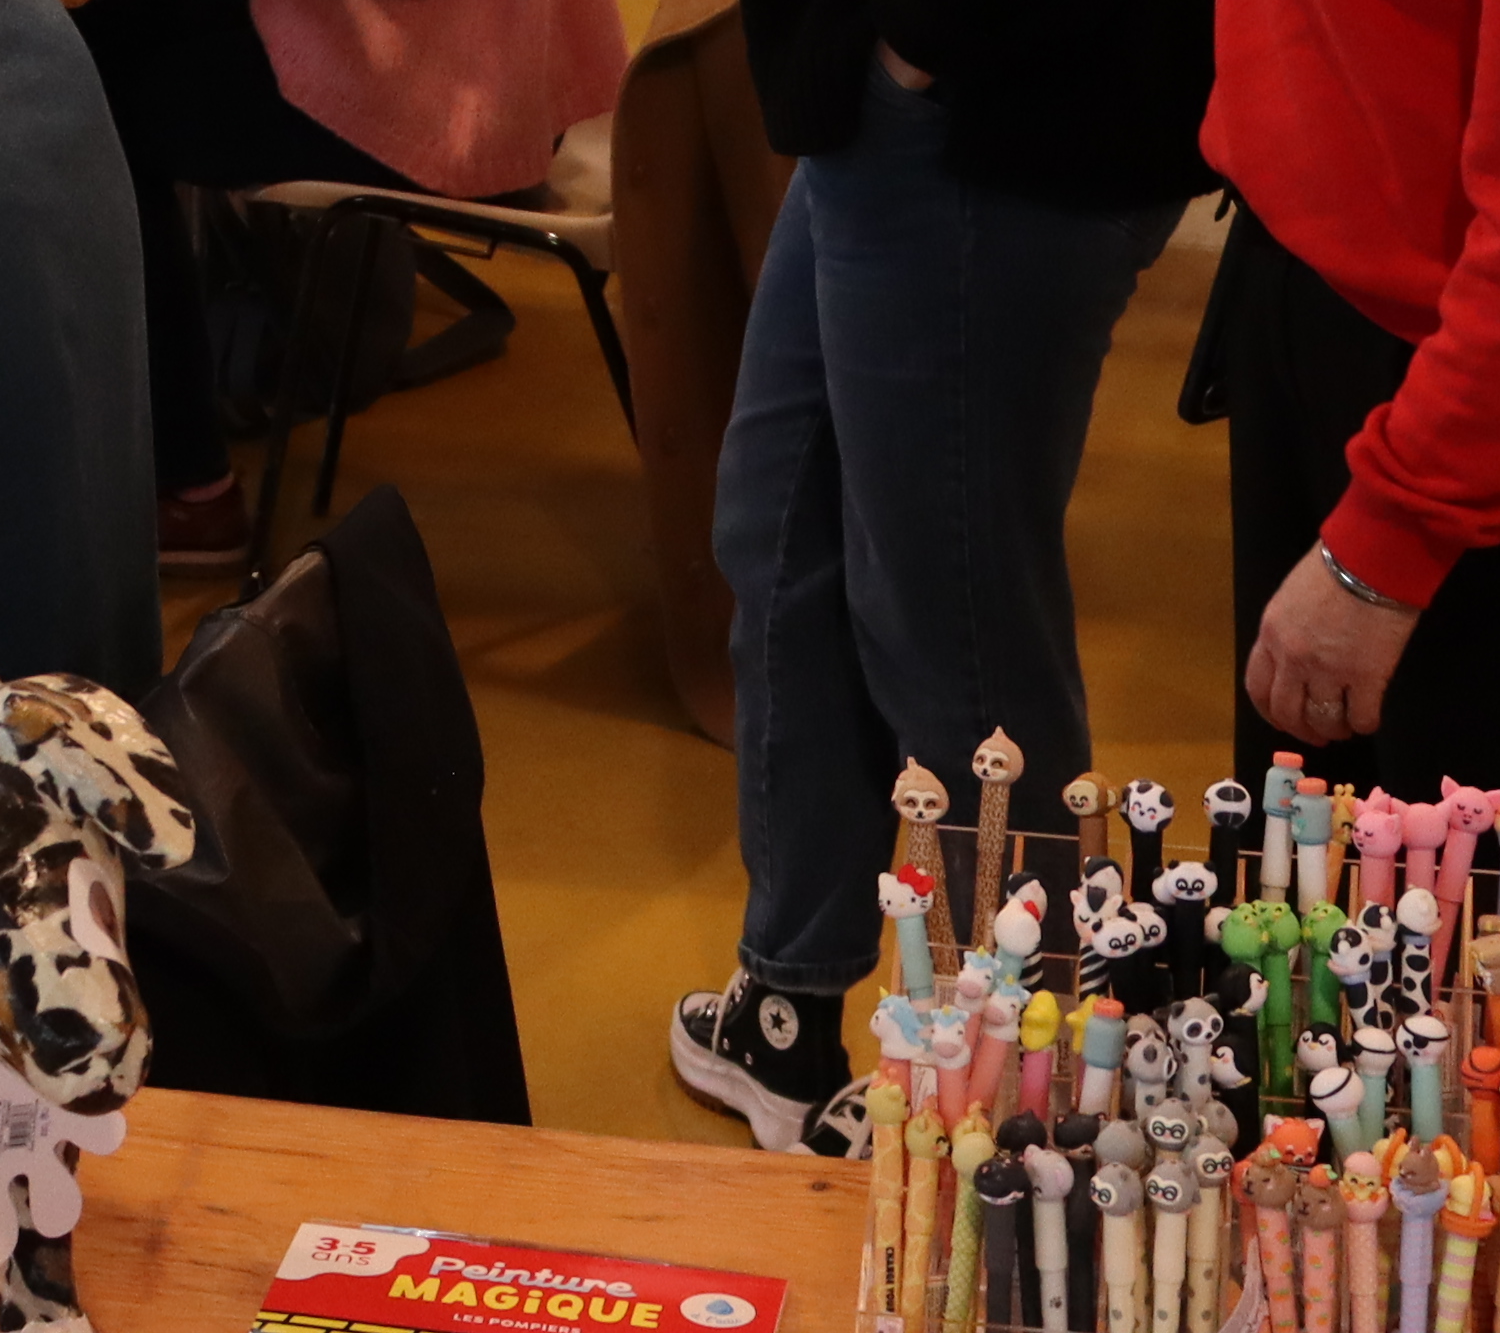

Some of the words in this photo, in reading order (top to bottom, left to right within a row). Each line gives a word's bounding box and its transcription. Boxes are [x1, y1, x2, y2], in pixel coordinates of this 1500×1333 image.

[313, 1235, 377, 1258] 3-5
[311, 1248, 372, 1268] ans
[428, 1255, 638, 1300] Peinture
[452, 1312, 484, 1325] LES
[487, 1315, 582, 1333] POMPIERS
